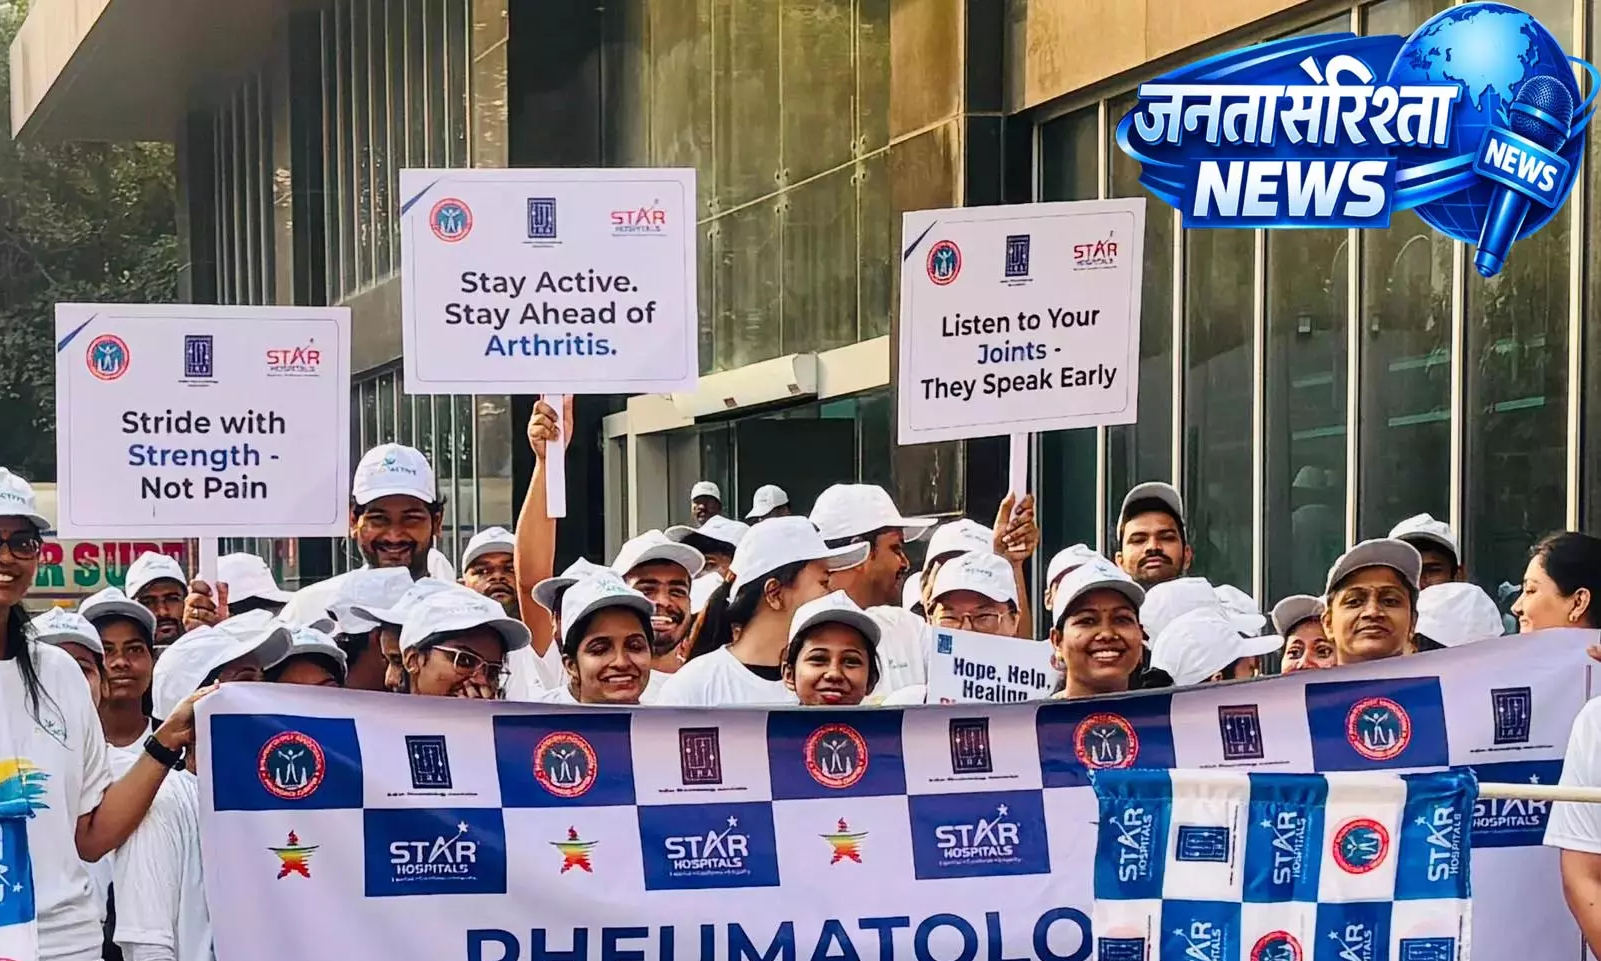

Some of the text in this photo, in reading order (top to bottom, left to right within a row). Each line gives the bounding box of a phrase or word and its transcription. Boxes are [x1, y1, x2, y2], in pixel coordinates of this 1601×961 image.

[610, 207, 666, 225] STAR
[1073, 240, 1118, 259] STAR
[461, 269, 638, 298] Stay Active.
[445, 301, 656, 330] Stay Ahead of
[942, 308, 1100, 337] Listen to Your
[267, 347, 320, 365] STAR
[484, 332, 617, 357] Arthritis.
[977, 340, 1047, 365] Joints
[921, 364, 1117, 401] They Speak Early
[121, 410, 286, 434] Stride with
[128, 443, 260, 471] Strength
[141, 474, 268, 499] Not Pain
[953, 657, 1051, 690] Hope, Help,
[935, 818, 1020, 848] STAR
[1473, 815, 1540, 827] HOSPITALS
[390, 836, 477, 864] STAR
[665, 830, 748, 859] STAR
[944, 845, 1013, 858] HOSPITALS
[1117, 807, 1144, 882] STAR
[1139, 815, 1153, 876] HOSPITALS
[1272, 811, 1298, 885] STAR
[1426, 806, 1455, 882] STAR
[1450, 813, 1462, 874] HOSPITALS
[396, 864, 469, 875] HOSPITALS
[674, 857, 743, 869] HOSPITALS
